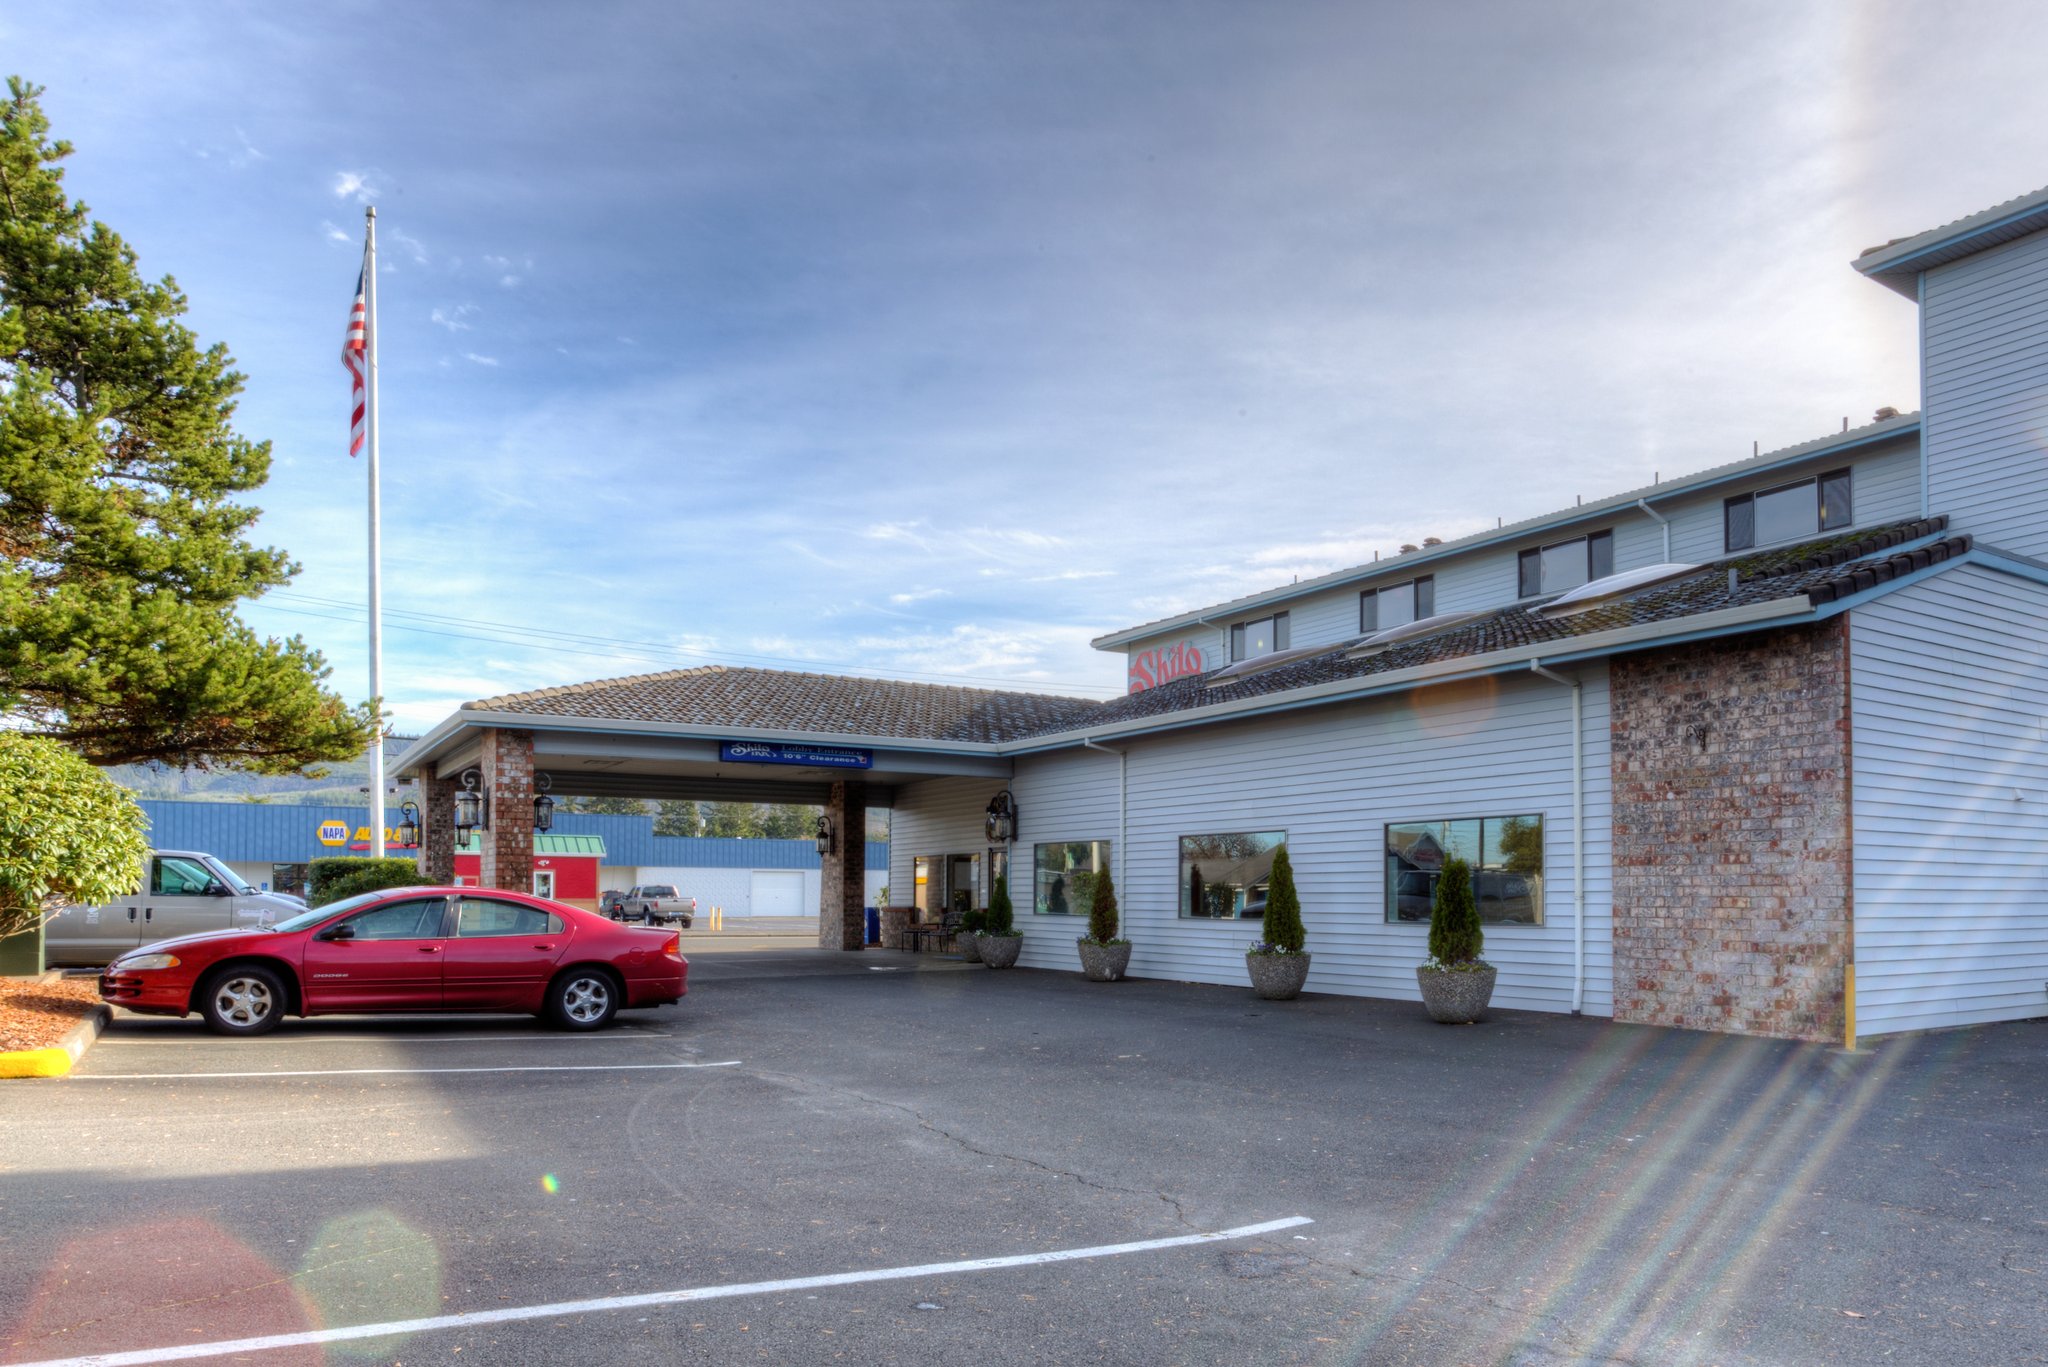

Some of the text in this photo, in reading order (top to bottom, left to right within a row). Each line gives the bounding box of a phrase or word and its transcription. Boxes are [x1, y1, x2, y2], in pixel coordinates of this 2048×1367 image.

[1129, 641, 1201, 695] Shilo
[730, 743, 770, 756] Shilo
[782, 745, 862, 755] Lobby Entrance
[809, 755, 856, 763] Clearance
[322, 827, 345, 840] NAPA
[353, 827, 393, 841] AUO
